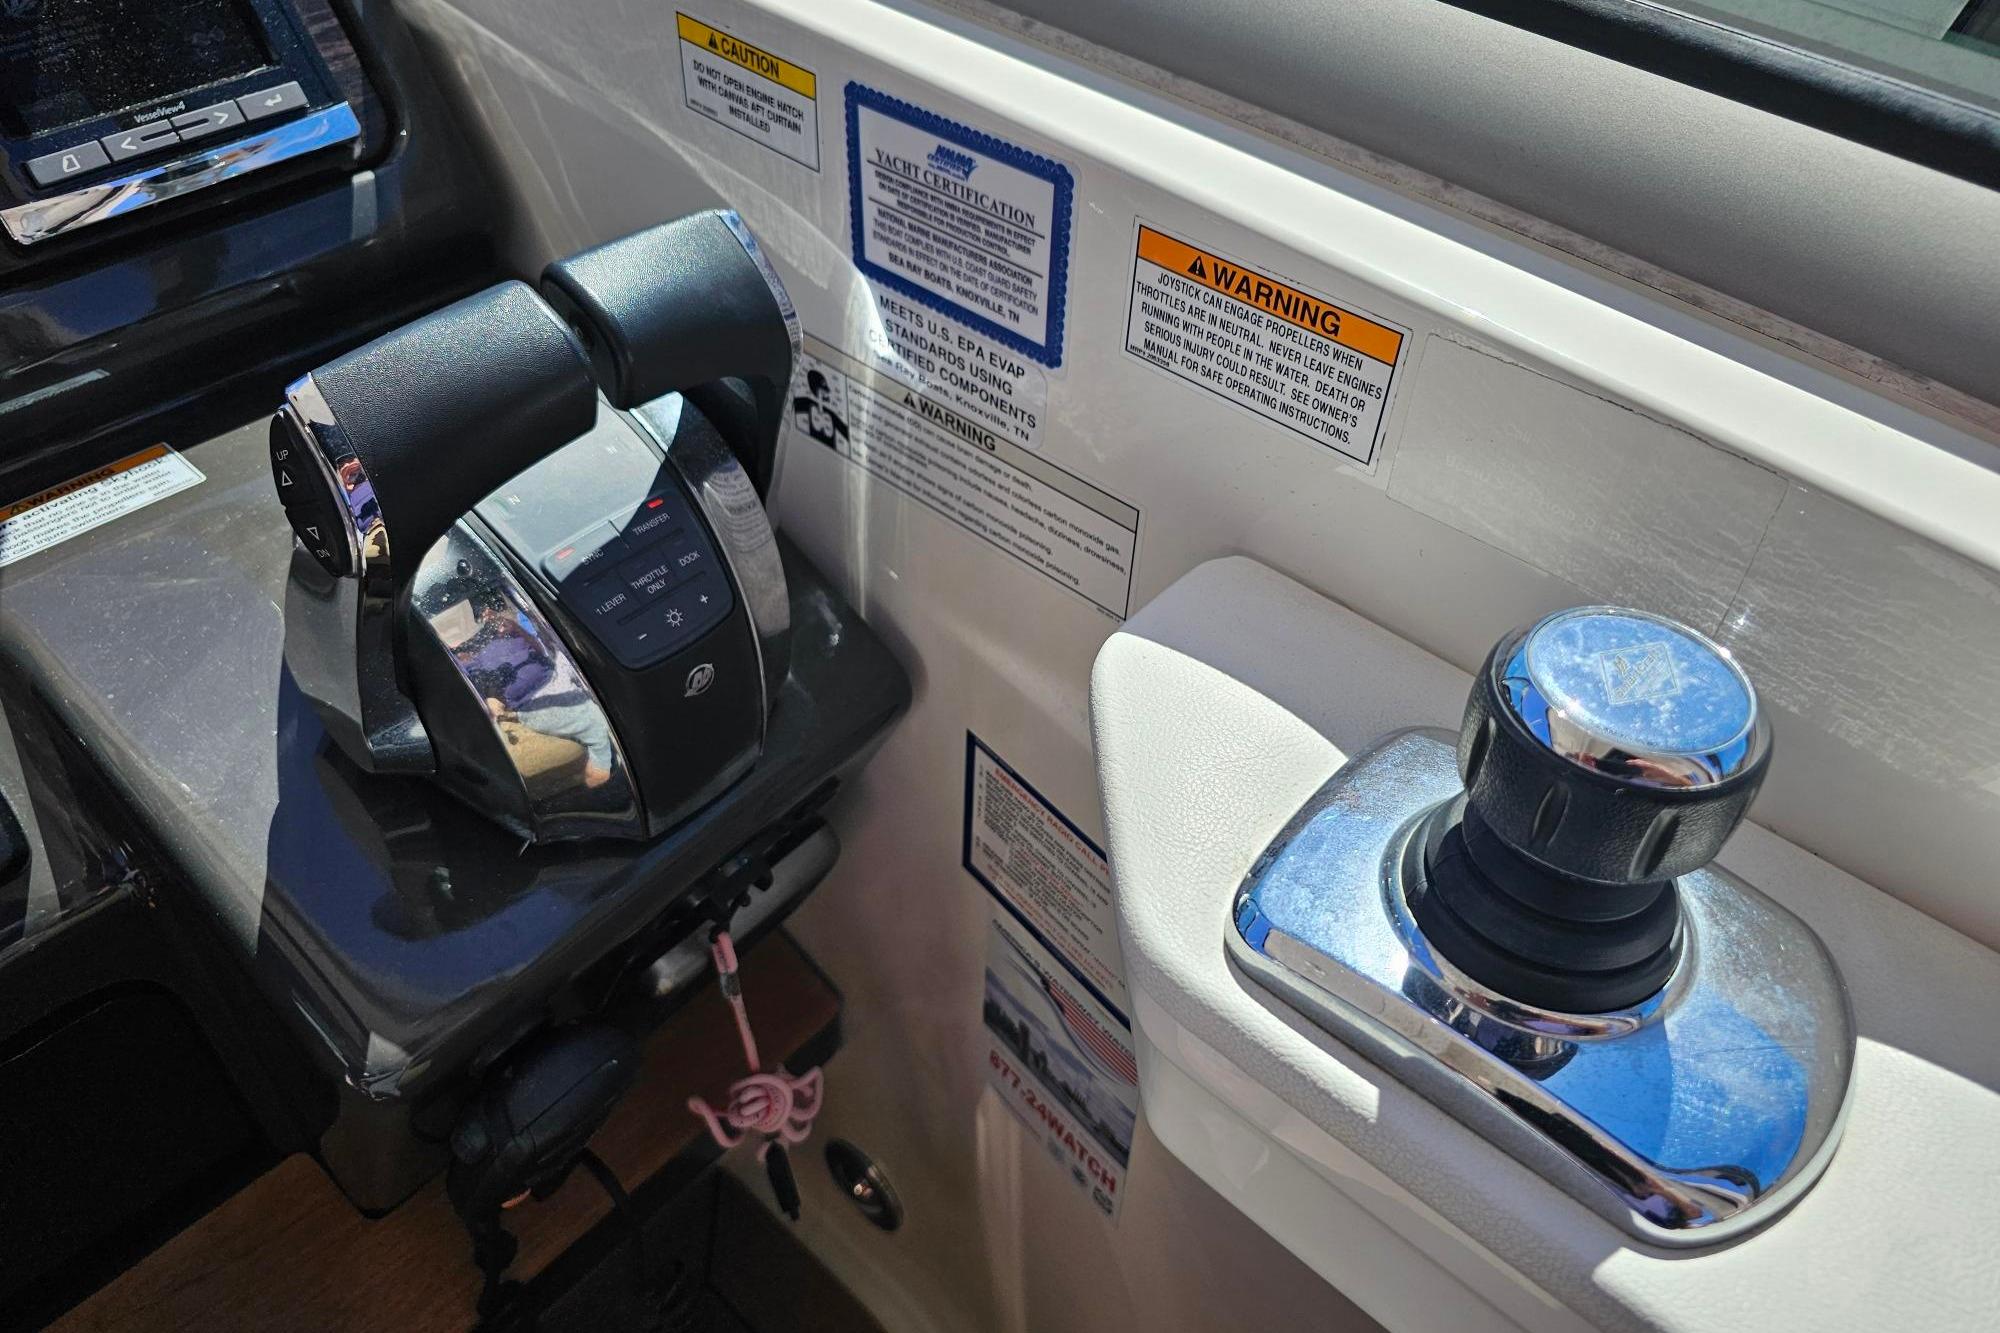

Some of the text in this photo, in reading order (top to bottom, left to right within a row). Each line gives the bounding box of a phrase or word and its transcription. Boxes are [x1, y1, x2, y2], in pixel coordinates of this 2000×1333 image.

[721, 36, 780, 80] CAUTION
[693, 60, 804, 122] DO NOT OPEN ENGINE HATCH
[697, 75, 717, 94] WITH
[718, 85, 749, 110] CANVAS
[750, 101, 766, 118] AFT
[767, 109, 801, 135] CURTAIN
[729, 105, 771, 134] INSTALLED
[875, 148, 921, 180] YACHT
[923, 168, 1036, 230] CERTIFICATION
[873, 229, 1039, 317] STANDARDS IN EFFECT ON THE DATE OF CERTIFICATION
[878, 208, 1033, 288] NATIONAL MARINE MANUFACTURERS ASSOCIATION
[906, 260, 922, 276] RAY
[1008, 310, 1020, 324] TN
[1157, 271, 1364, 372] JOYSTICK CAN ENGAGE PROPELLERS WHEN
[1211, 263, 1343, 338] WARNING
[879, 295, 1025, 382] MEETS U.S. EPA EVAP
[885, 318, 1013, 398] STANDARDS USING
[1136, 281, 1384, 401] THROTTLES ARE IN NEUTRAL. NEVER LEAVE ENGINES
[1141, 301, 1367, 413] RUNNING WITH PEOPLE IN THE WATER. DEATH OR
[868, 327, 1037, 434] CERTIFIED COMPONENTS
[1143, 338, 1353, 445] MANUAL FOR SAFE OPERATING INSTRUCTIONS.
[1144, 320, 1359, 429] SERIOUS INJURY COULD RESULT. SEE OWNER'S
[918, 373, 953, 402] Boats,
[955, 393, 1010, 435] Knoxville,
[1013, 425, 1030, 442] TN
[918, 398, 996, 453] WARNING
[275, 449, 289, 461] UP
[22, 486, 98, 521] activating
[28, 467, 116, 509] WARNING
[316, 549, 331, 558] DN
[632, 512, 670, 536] TRANSFER
[1043, 507, 1068, 527] carbon
[1068, 521, 1104, 547] monoxide
[582, 549, 604, 566] SYNC
[631, 564, 669, 590] THROTTLE
[647, 579, 667, 595] ONLY
[679, 551, 701, 568] DOCK
[1083, 545, 1127, 576] drowsiness,
[602, 592, 627, 614] LEVER
